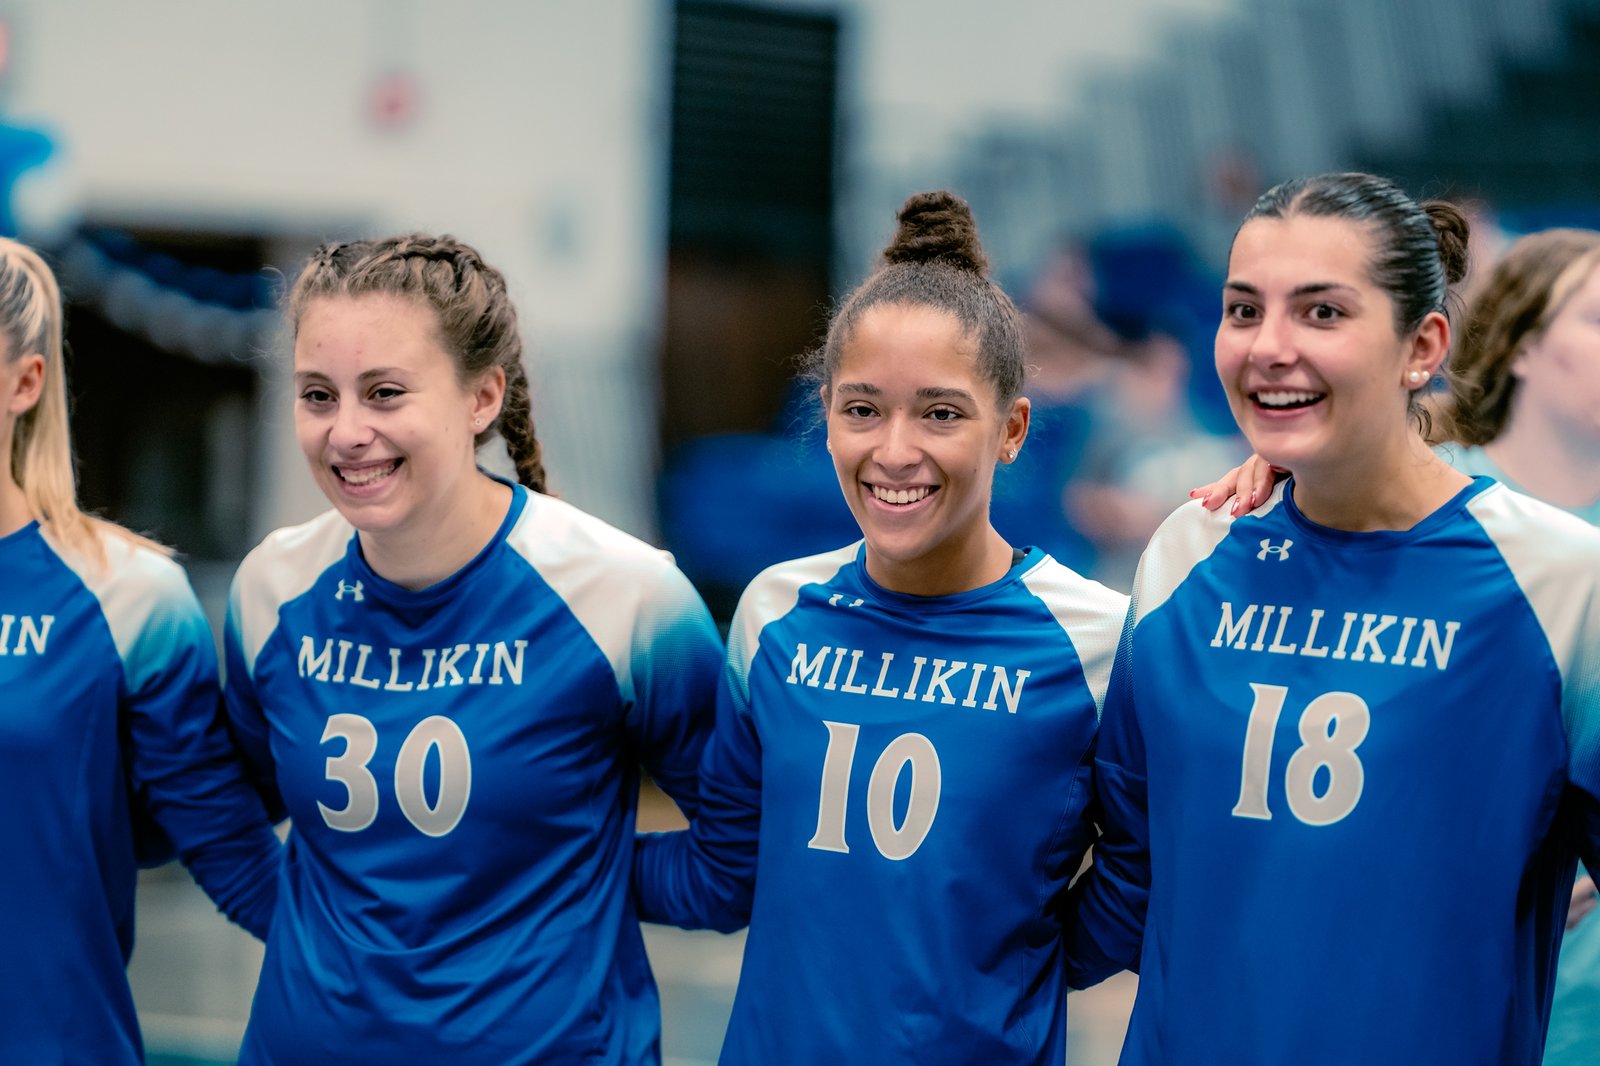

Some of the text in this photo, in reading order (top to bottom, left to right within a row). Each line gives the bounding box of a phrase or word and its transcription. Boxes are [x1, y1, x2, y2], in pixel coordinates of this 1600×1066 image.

[298, 635, 528, 691] MILLIKIN
[786, 642, 1032, 714] MILLIKIN
[1210, 601, 1461, 670] MILLIKIN
[317, 713, 472, 837] 30
[807, 720, 942, 861] 10
[1232, 682, 1371, 826] 18
